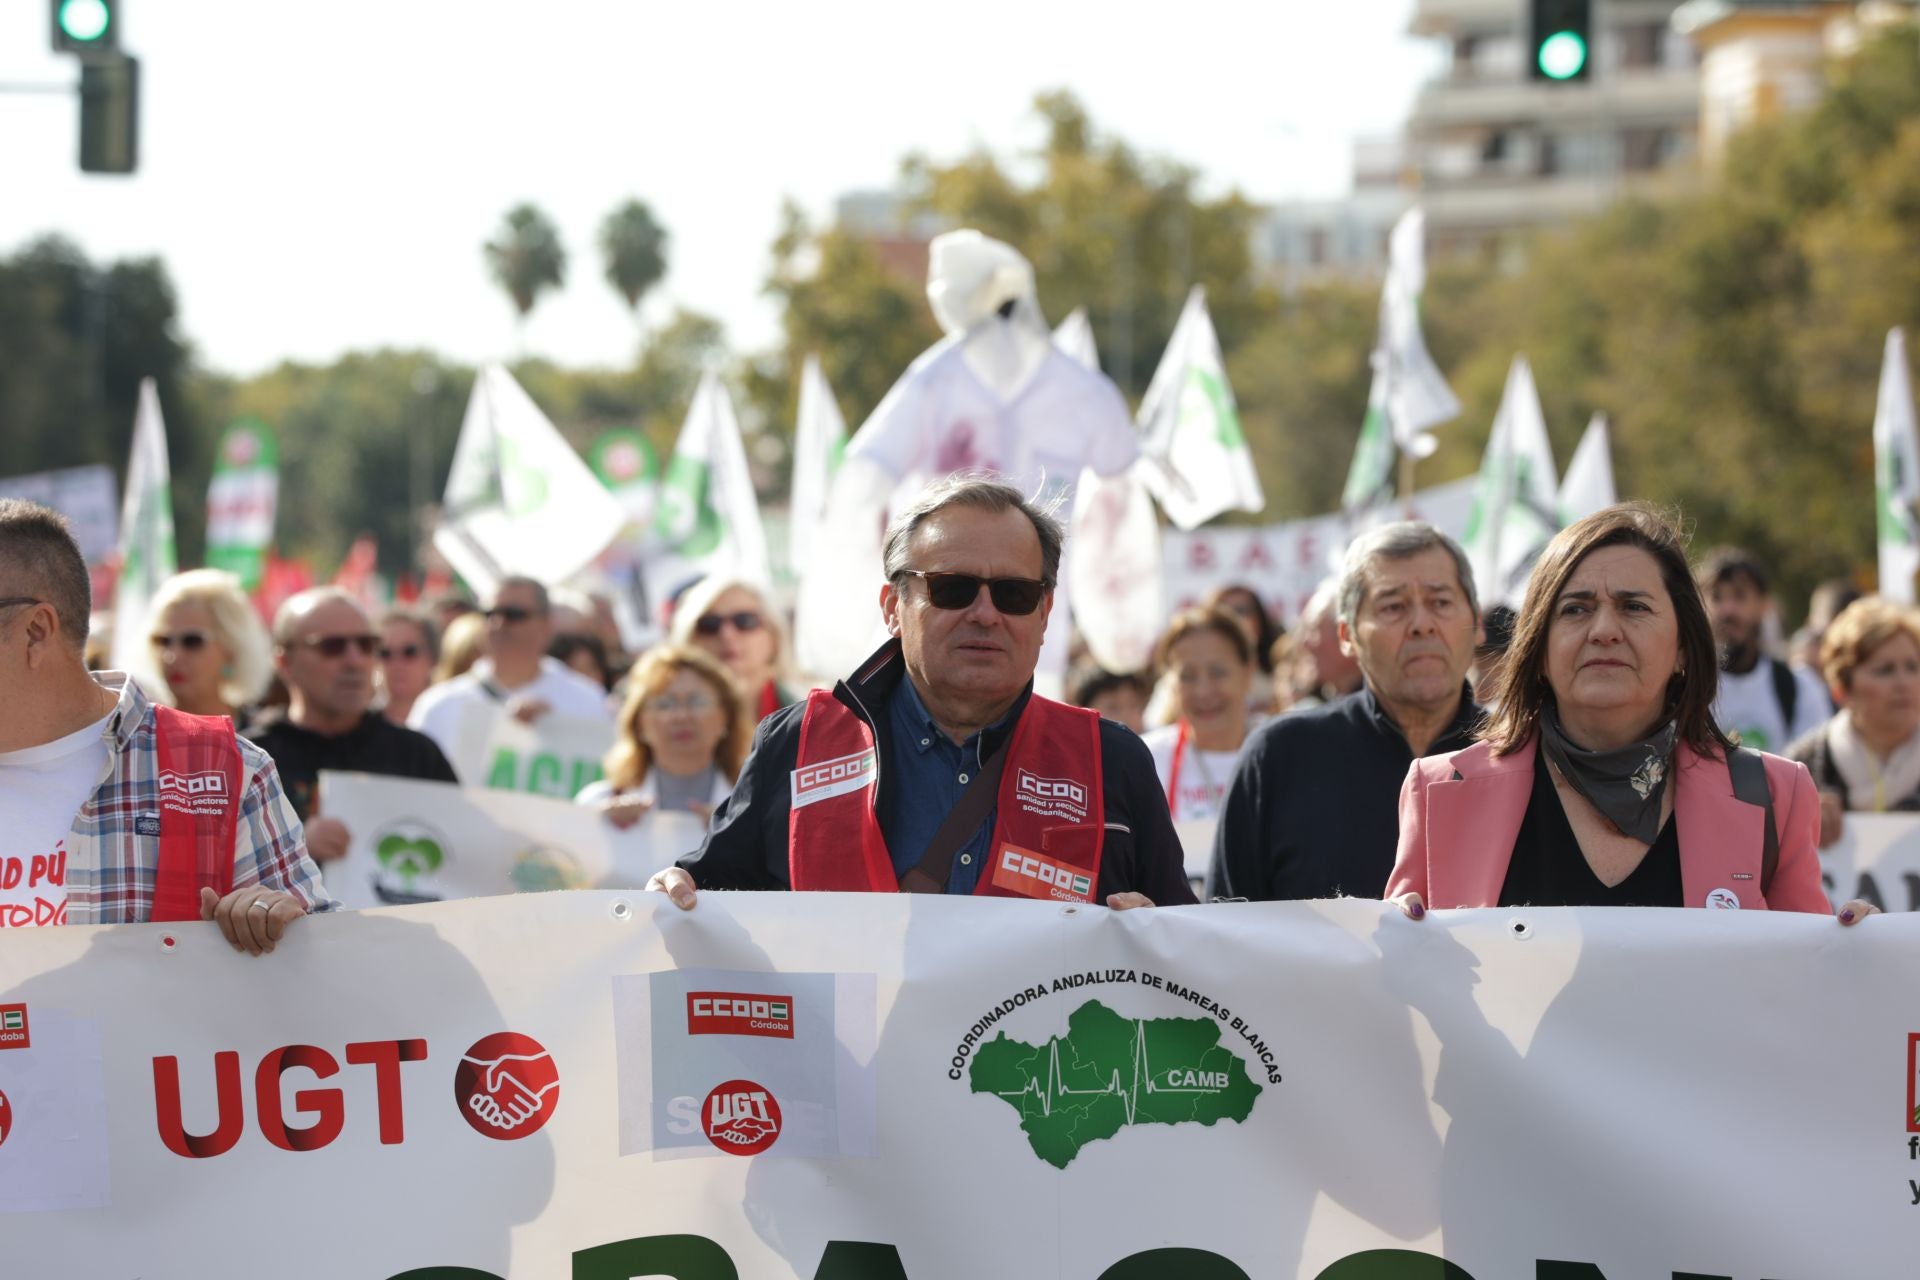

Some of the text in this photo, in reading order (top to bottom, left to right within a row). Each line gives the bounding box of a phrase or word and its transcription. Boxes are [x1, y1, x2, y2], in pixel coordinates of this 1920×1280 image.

[159, 774, 222, 794] CCOO
[801, 759, 861, 789] CCOO
[160, 793, 186, 805] anidad
[193, 797, 229, 805] sectores
[1022, 775, 1083, 803] CCOO
[164, 803, 223, 815] sociosanitarios
[1016, 794, 1047, 808] sanidad
[1056, 801, 1087, 817] sectores
[1022, 804, 1081, 823] sociosanitarios
[1002, 851, 1073, 890] CCOO
[693, 998, 770, 1019] CCOO
[750, 1019, 790, 1032] Córdoba
[948, 969, 1283, 1085] COORDINADORA ANDALUZA DE MAREAS BLANCAS
[1167, 1069, 1230, 1089] CAMB
[152, 1038, 428, 1159] UGT
[711, 1091, 769, 1123] UGT
